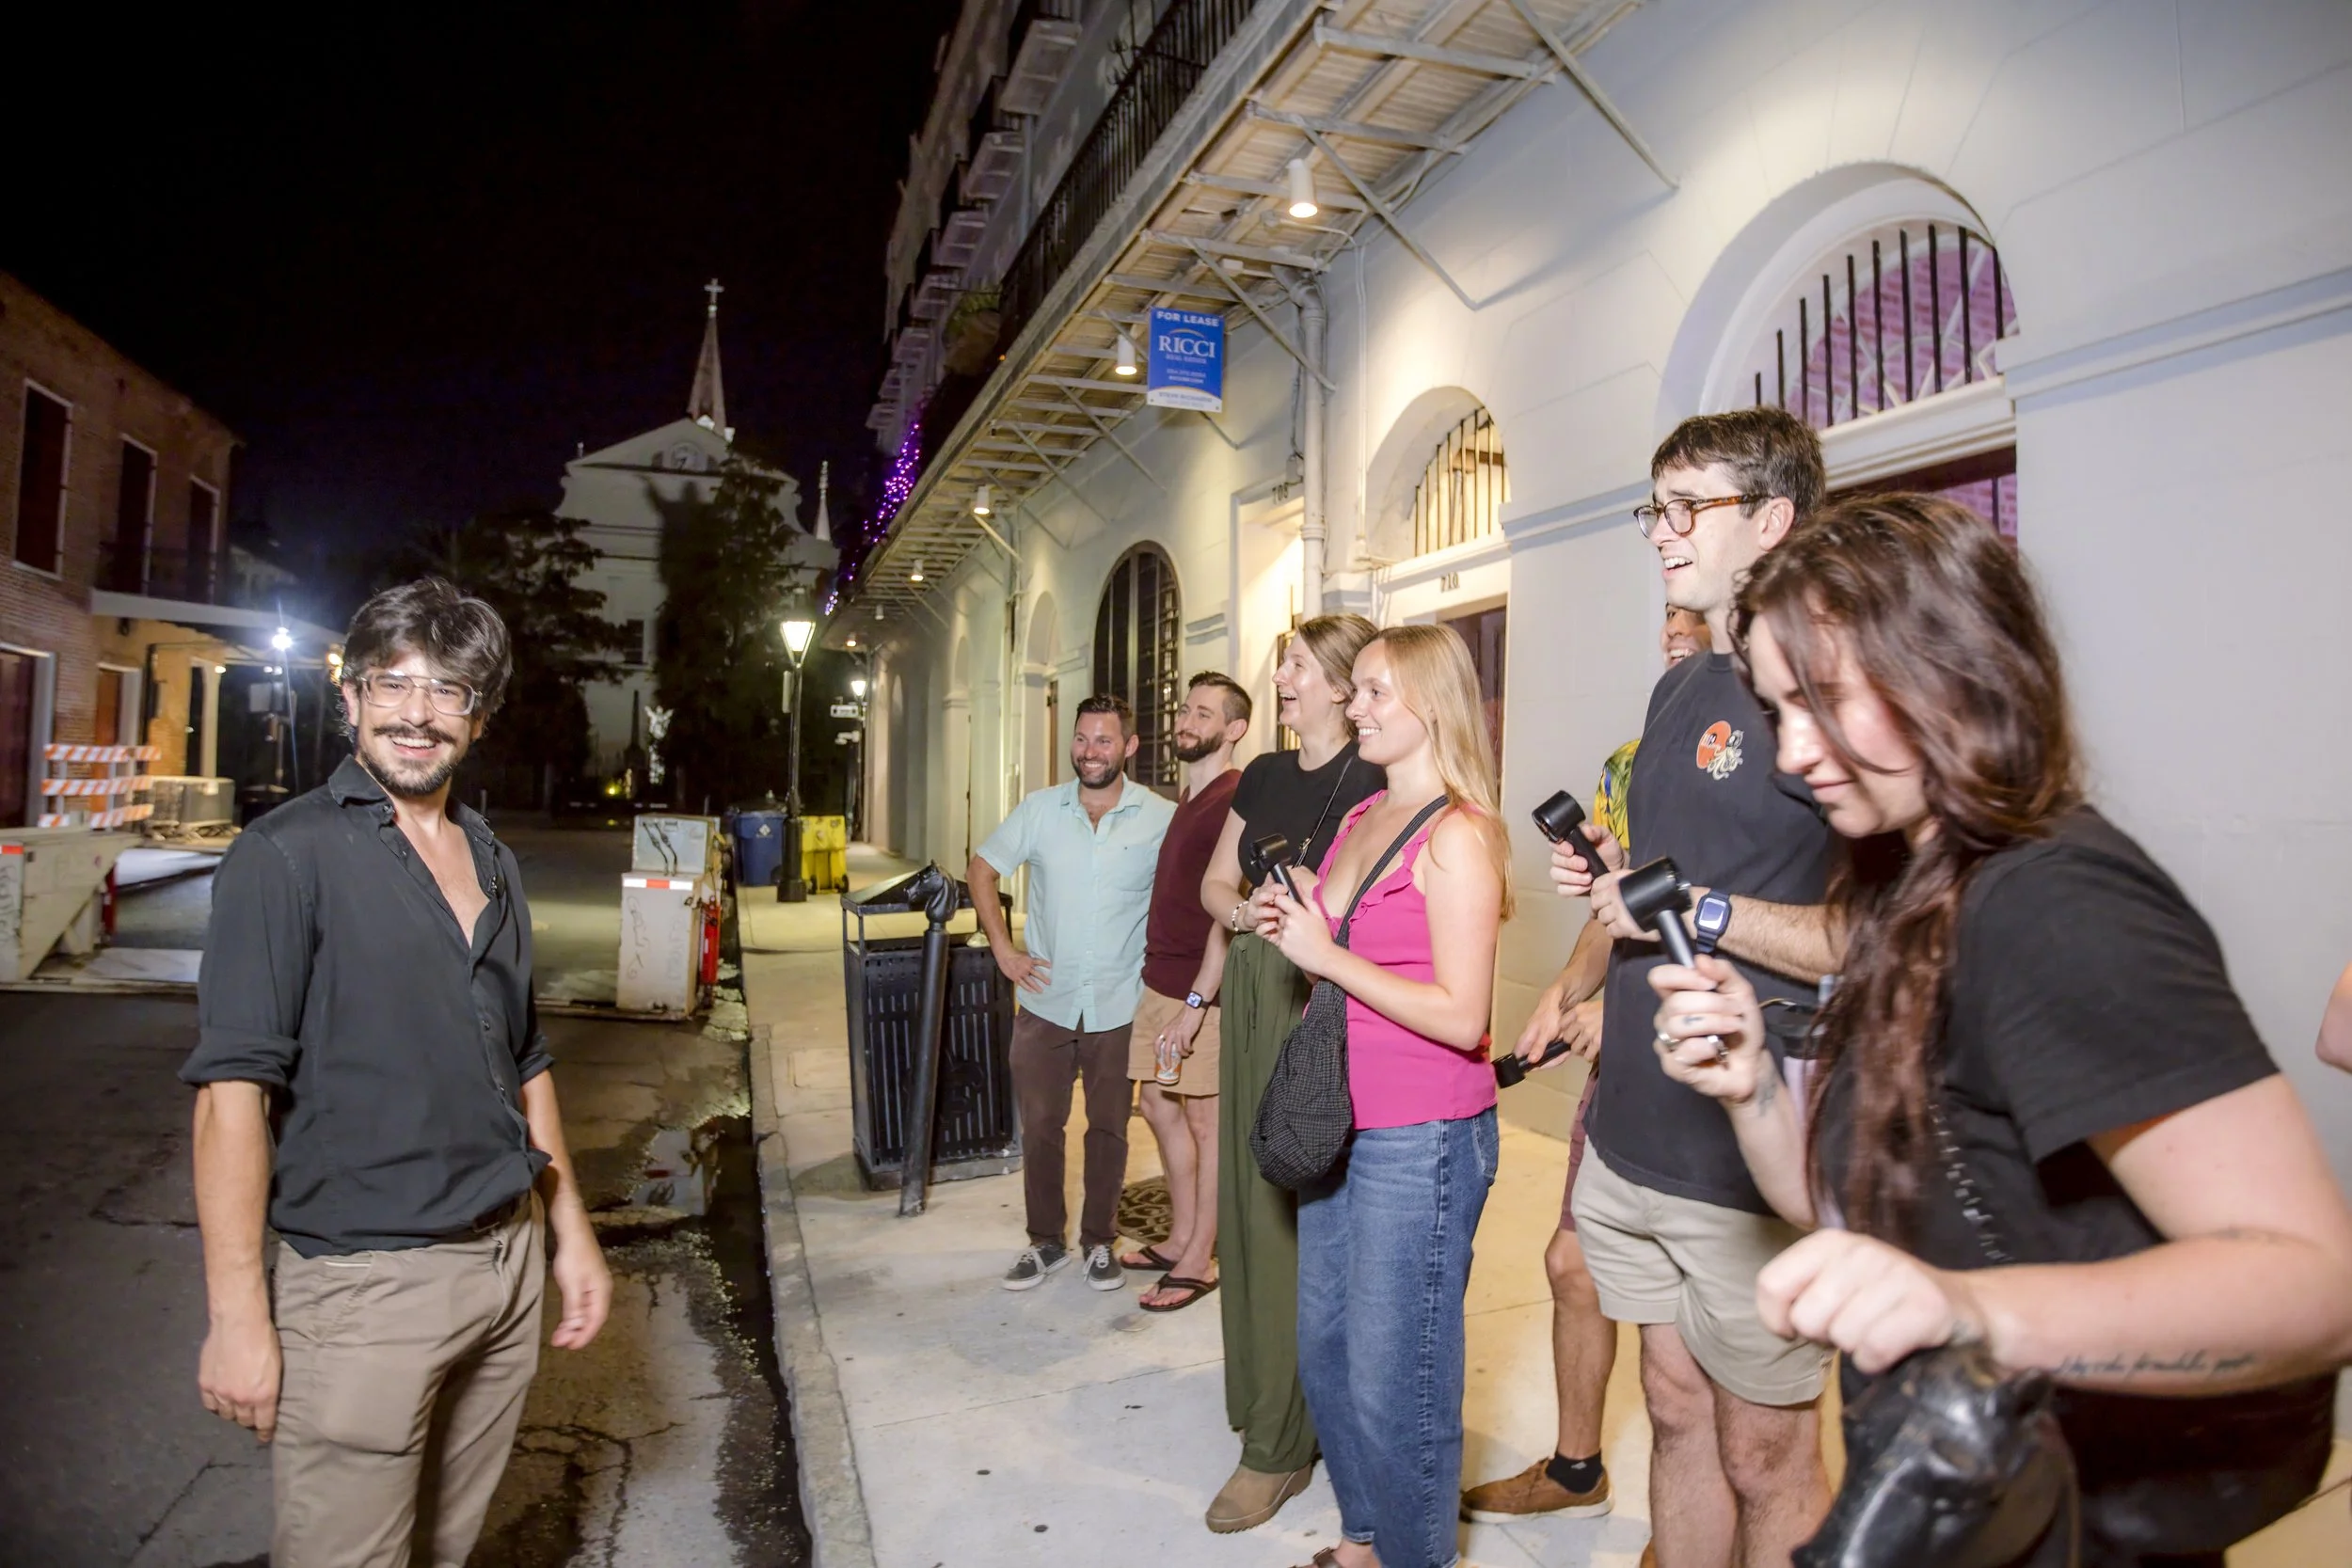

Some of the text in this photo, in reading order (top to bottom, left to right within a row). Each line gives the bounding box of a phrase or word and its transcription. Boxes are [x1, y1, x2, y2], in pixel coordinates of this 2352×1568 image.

[1157, 311, 1219, 326] FOR LEASE
[1158, 334, 1216, 358] RICCI
